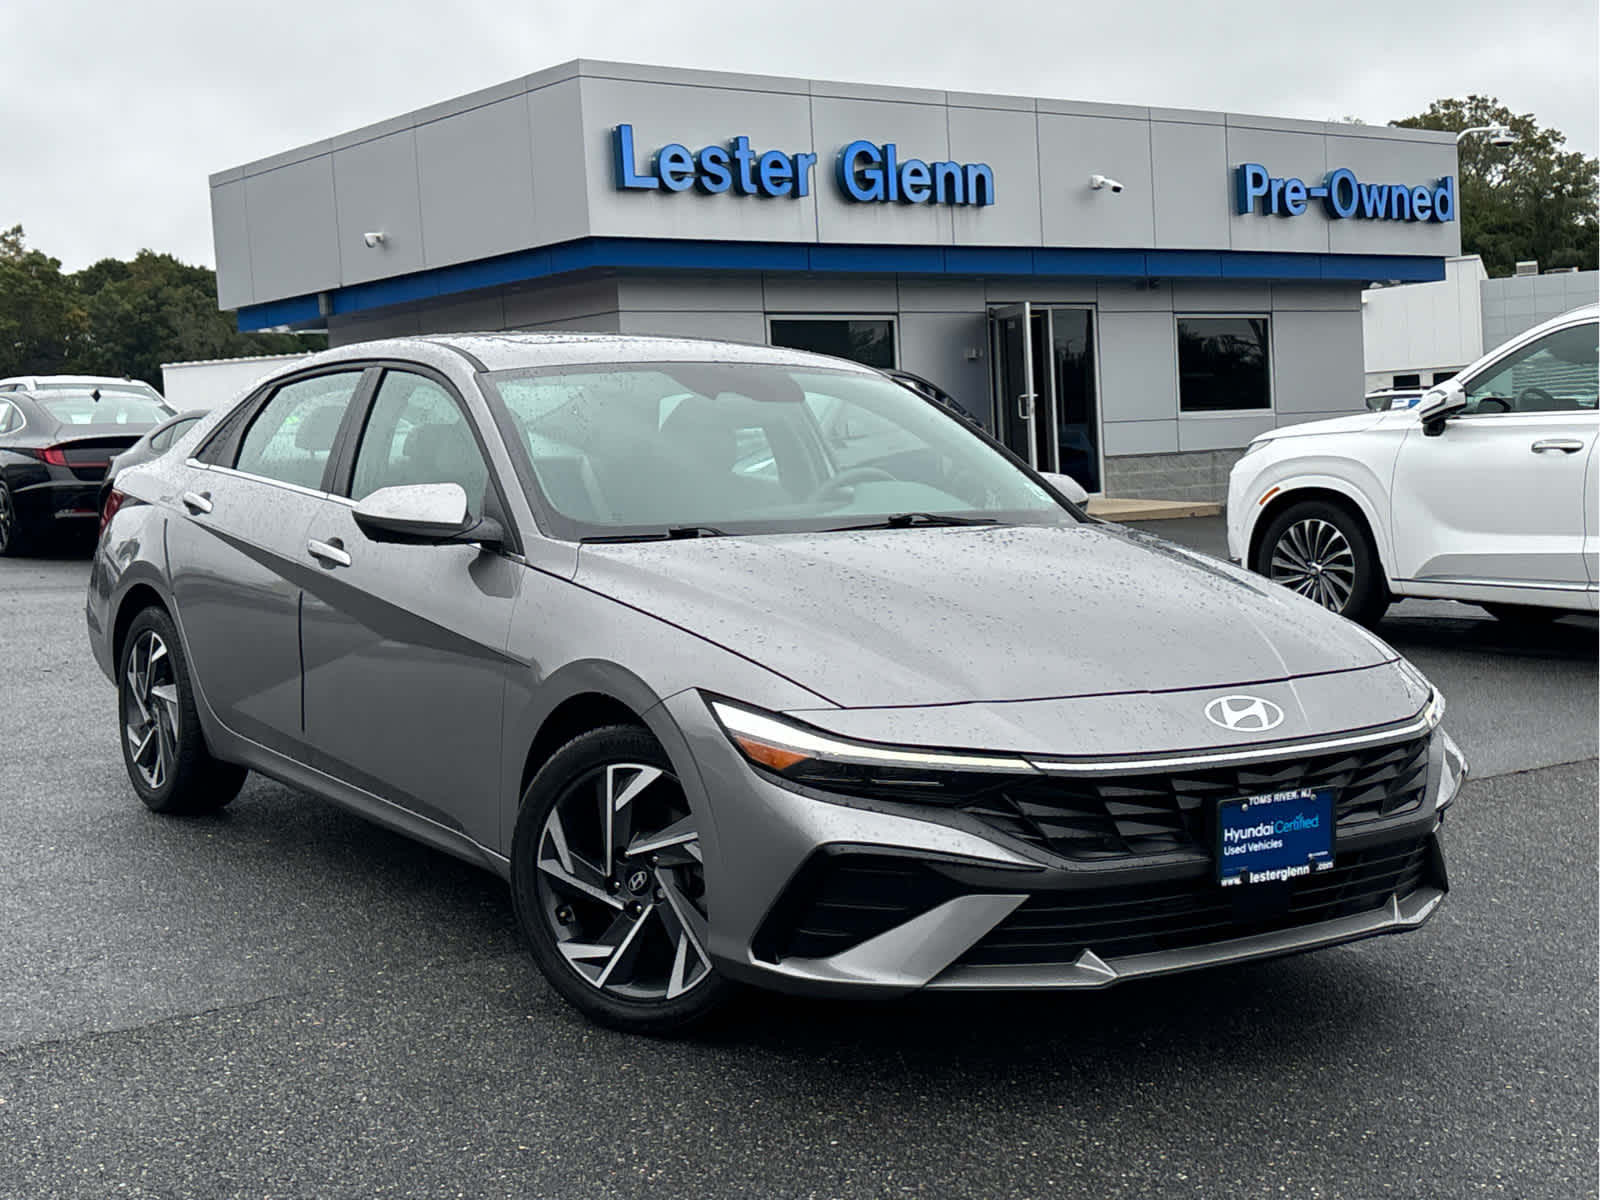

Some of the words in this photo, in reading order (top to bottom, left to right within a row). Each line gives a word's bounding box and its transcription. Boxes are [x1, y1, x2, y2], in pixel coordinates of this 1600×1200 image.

[611, 123, 817, 199] Lester
[837, 139, 994, 207] Glenn
[1237, 162, 1456, 222] Pre-Owned
[1248, 794, 1272, 806] TOMS
[1301, 788, 1312, 798] NJ
[1224, 844, 1246, 856] Used
[1247, 838, 1283, 853] Vehicles
[1249, 865, 1310, 884] lesterglenn
